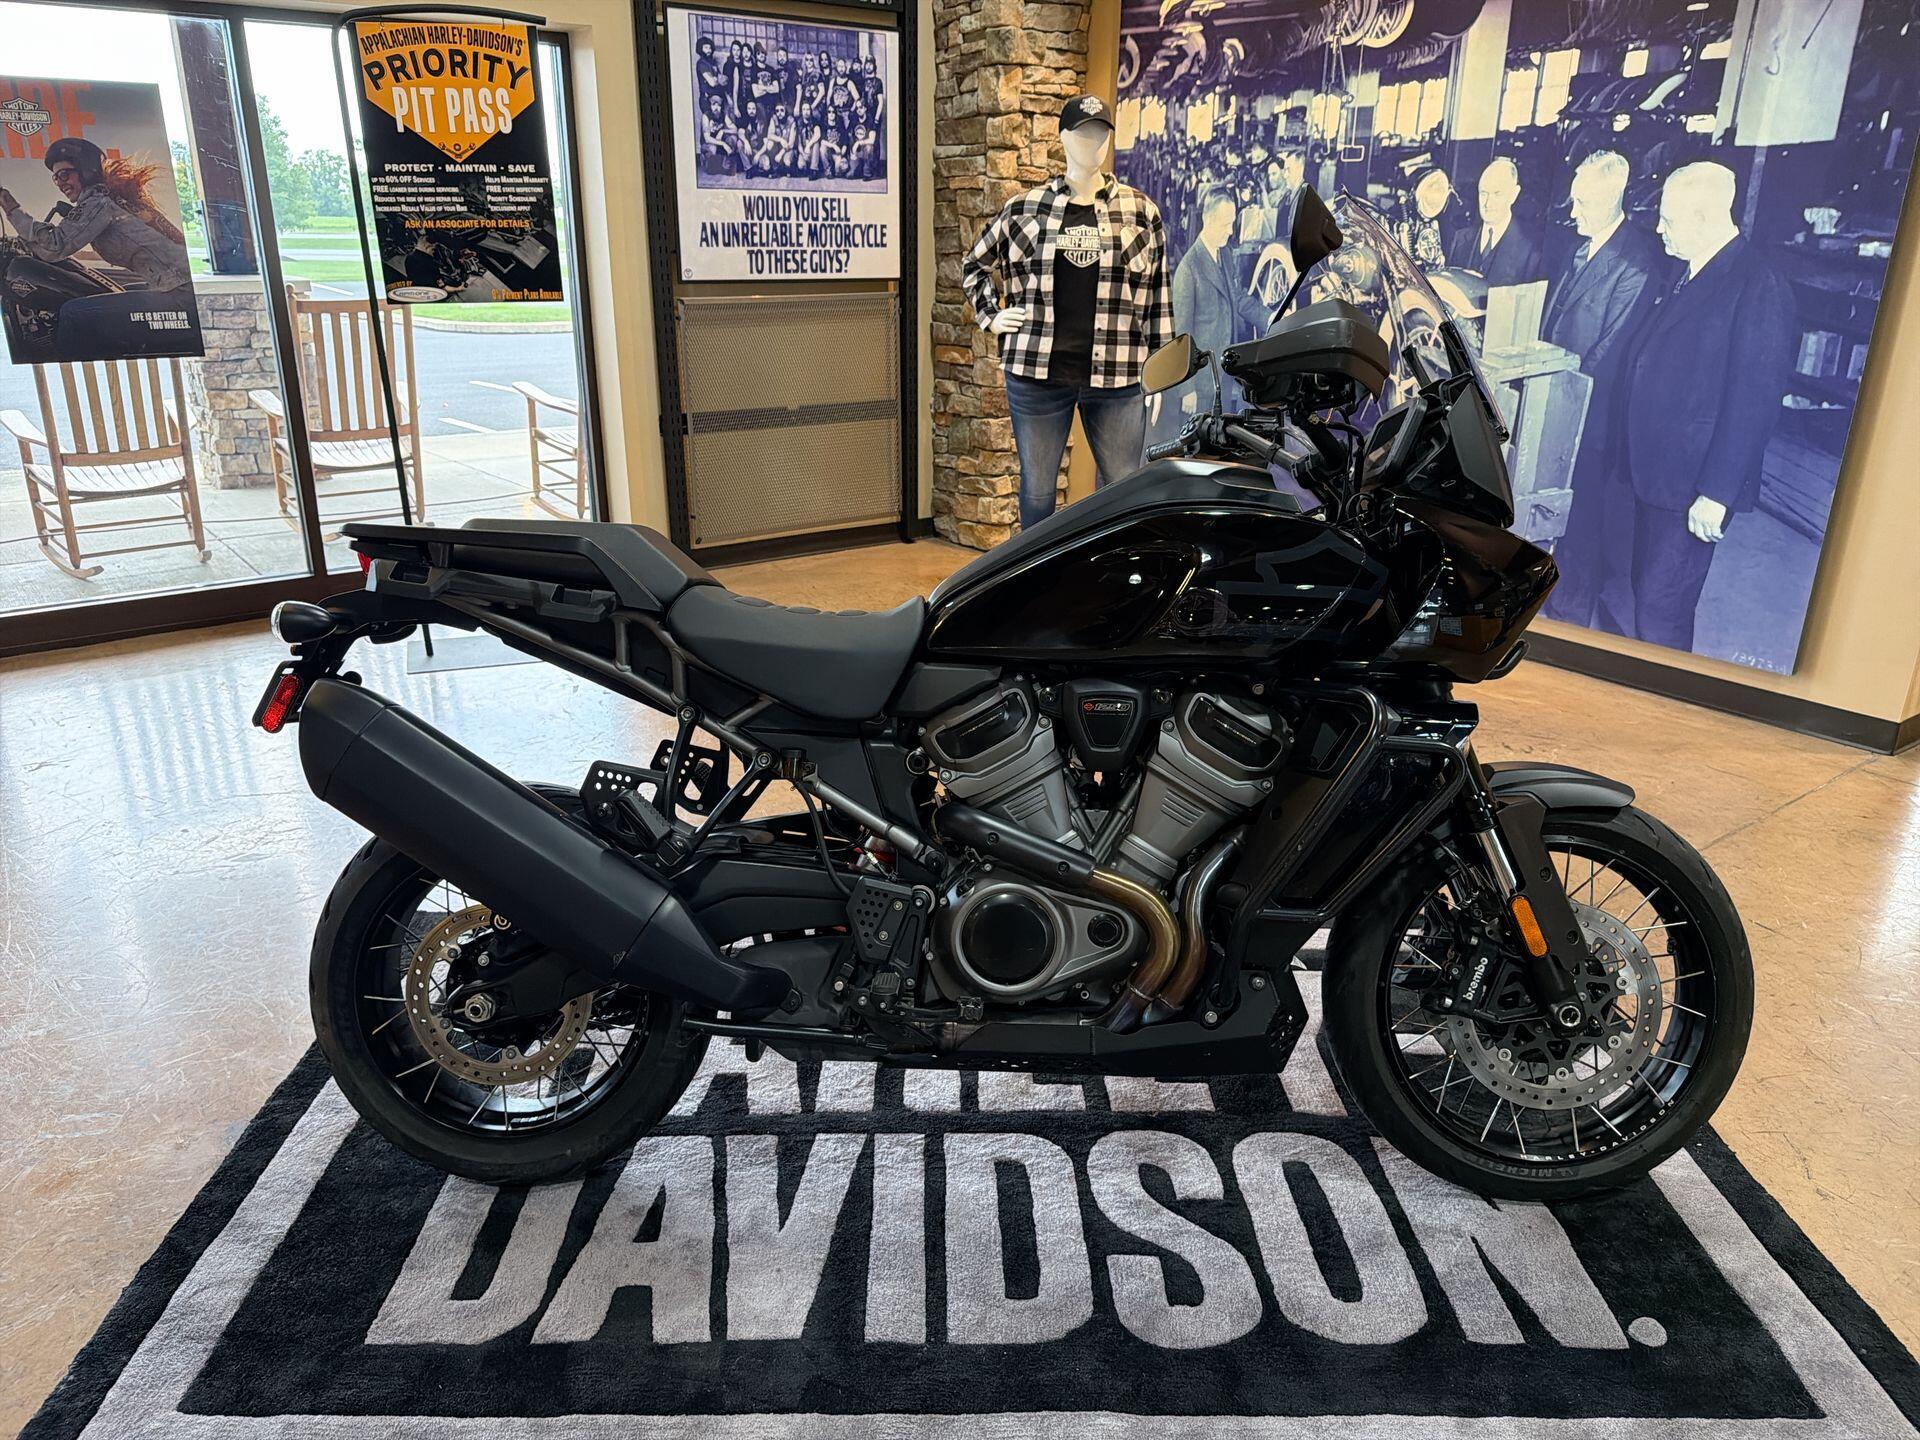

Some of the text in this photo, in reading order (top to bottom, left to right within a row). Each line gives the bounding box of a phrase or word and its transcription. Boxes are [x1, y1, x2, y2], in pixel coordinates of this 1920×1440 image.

[360, 26, 524, 57] APPALACHIAN HARLEY-DAVIDSON'S
[363, 48, 529, 91] PRIORITY
[392, 86, 513, 135] PIT PASS
[384, 163, 536, 172] PROTECT MAINTAIN SAVE
[373, 185, 389, 193] FREE
[486, 185, 501, 193] FREE
[742, 195, 850, 222] WOULD YOU SELL
[405, 219, 530, 228] ASK AN ASSOCIATE FOR DETAILS
[1070, 228, 1098, 236] MOTOR
[699, 222, 887, 248] AN UNRELIABLE MOTORCYCLE
[747, 249, 850, 275] TO THESE GUYS?
[1068, 251, 1097, 264] CYCLES
[130, 311, 188, 321] LIFE IS BETTER ON
[148, 320, 191, 330] TWO WHEELS.
[1462, 957, 1489, 1001] brembo
[1520, 1099, 1675, 1161] HARLEY-DAVIDSON
